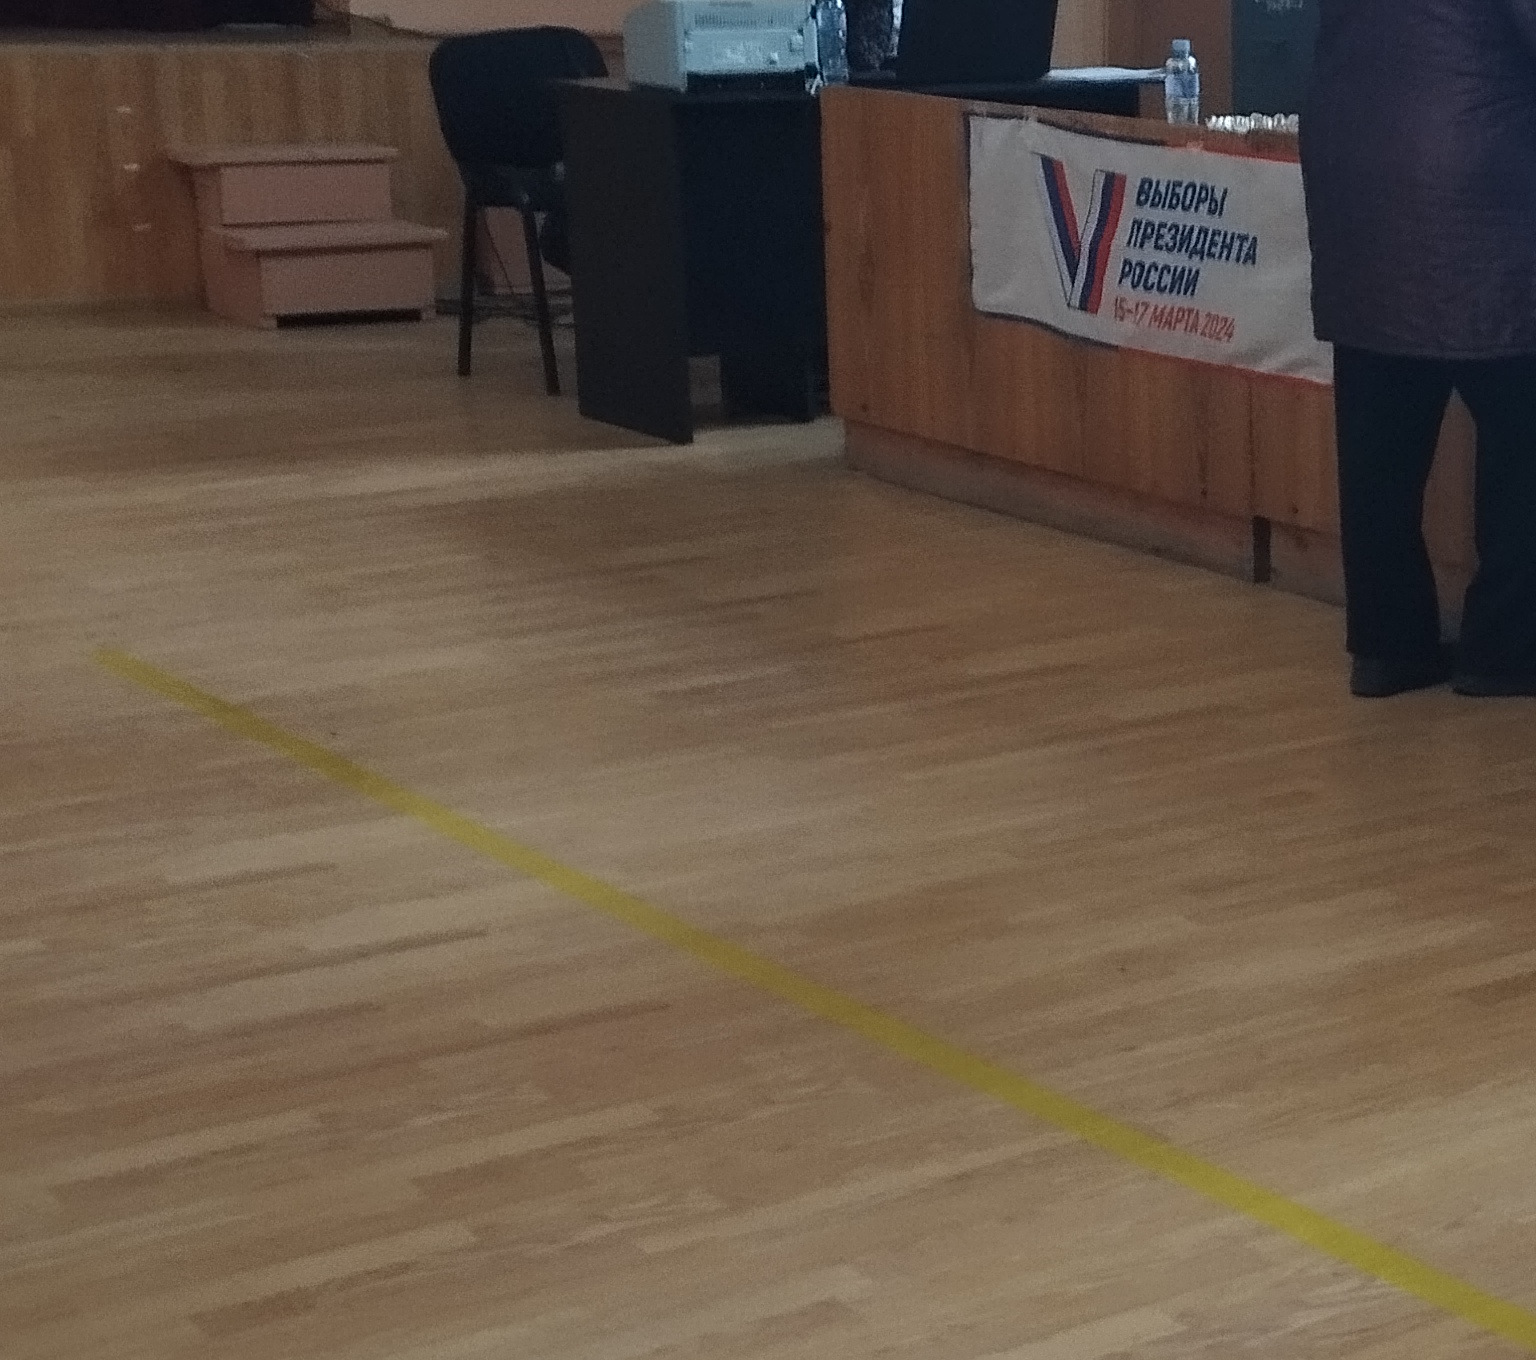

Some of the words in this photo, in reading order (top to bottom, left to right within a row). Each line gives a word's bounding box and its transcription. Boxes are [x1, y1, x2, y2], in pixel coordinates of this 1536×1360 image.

[1135, 177, 1229, 217] ВЫБОРЫ
[1126, 217, 1258, 266] ПРЕЗИДЕНТА
[1118, 257, 1200, 296] РОССИИ
[1150, 304, 1200, 335] МАРТА
[1200, 311, 1236, 342] 2024
